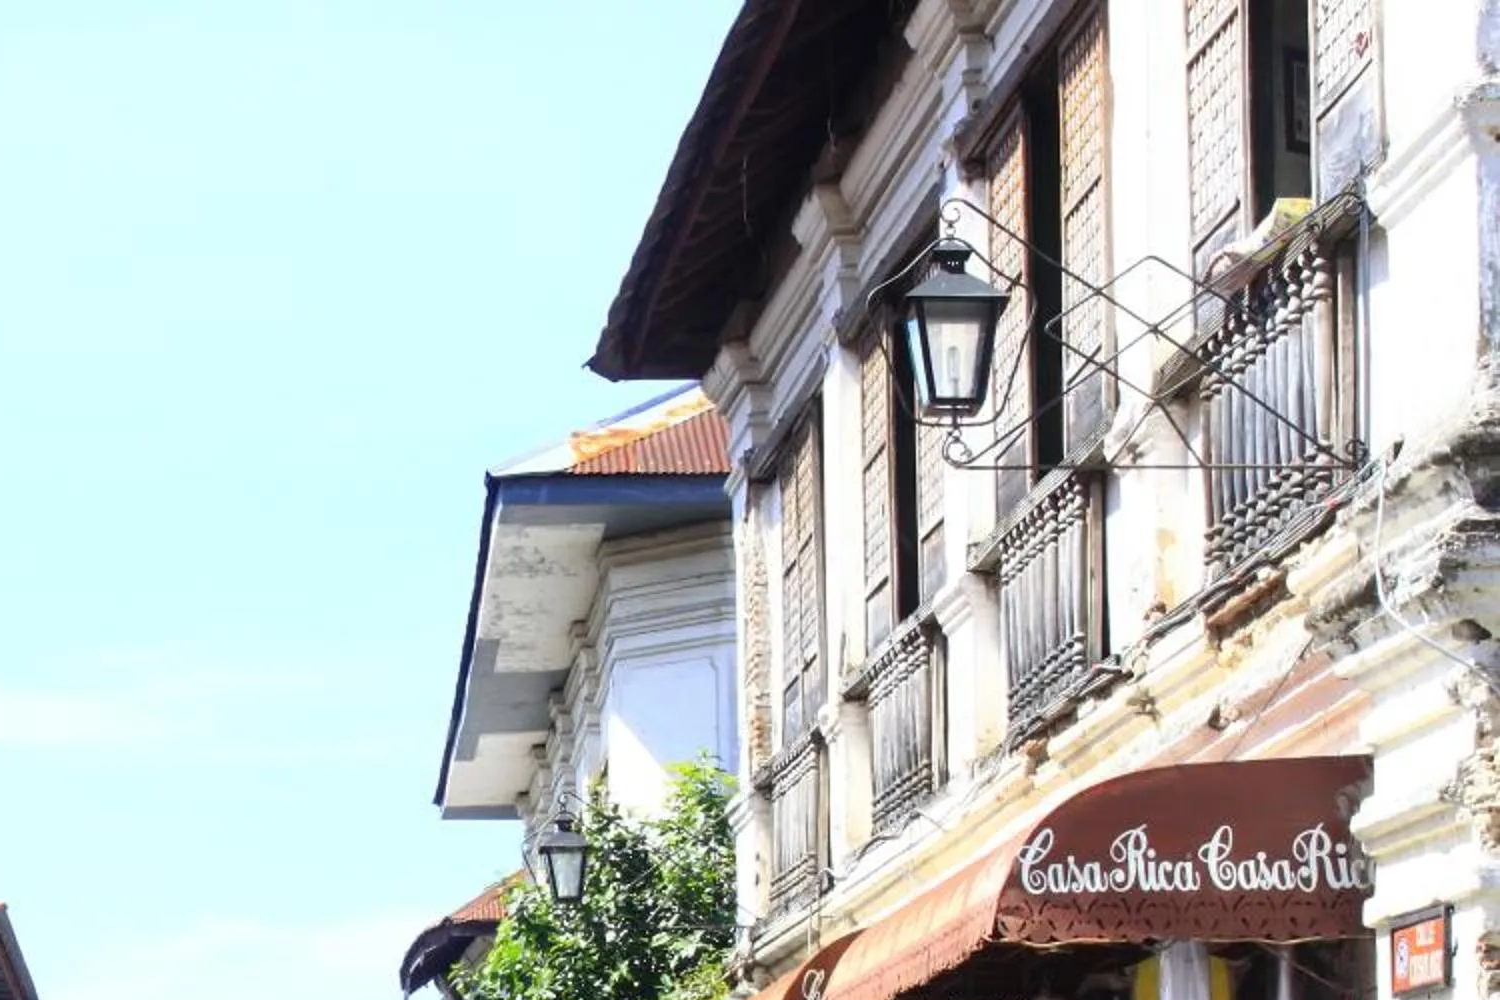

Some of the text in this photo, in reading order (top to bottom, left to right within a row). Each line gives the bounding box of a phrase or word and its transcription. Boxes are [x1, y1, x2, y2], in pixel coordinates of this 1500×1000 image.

[1019, 828, 1108, 894] Casa
[1109, 823, 1199, 892] Rica
[1198, 825, 1296, 892] Casa
